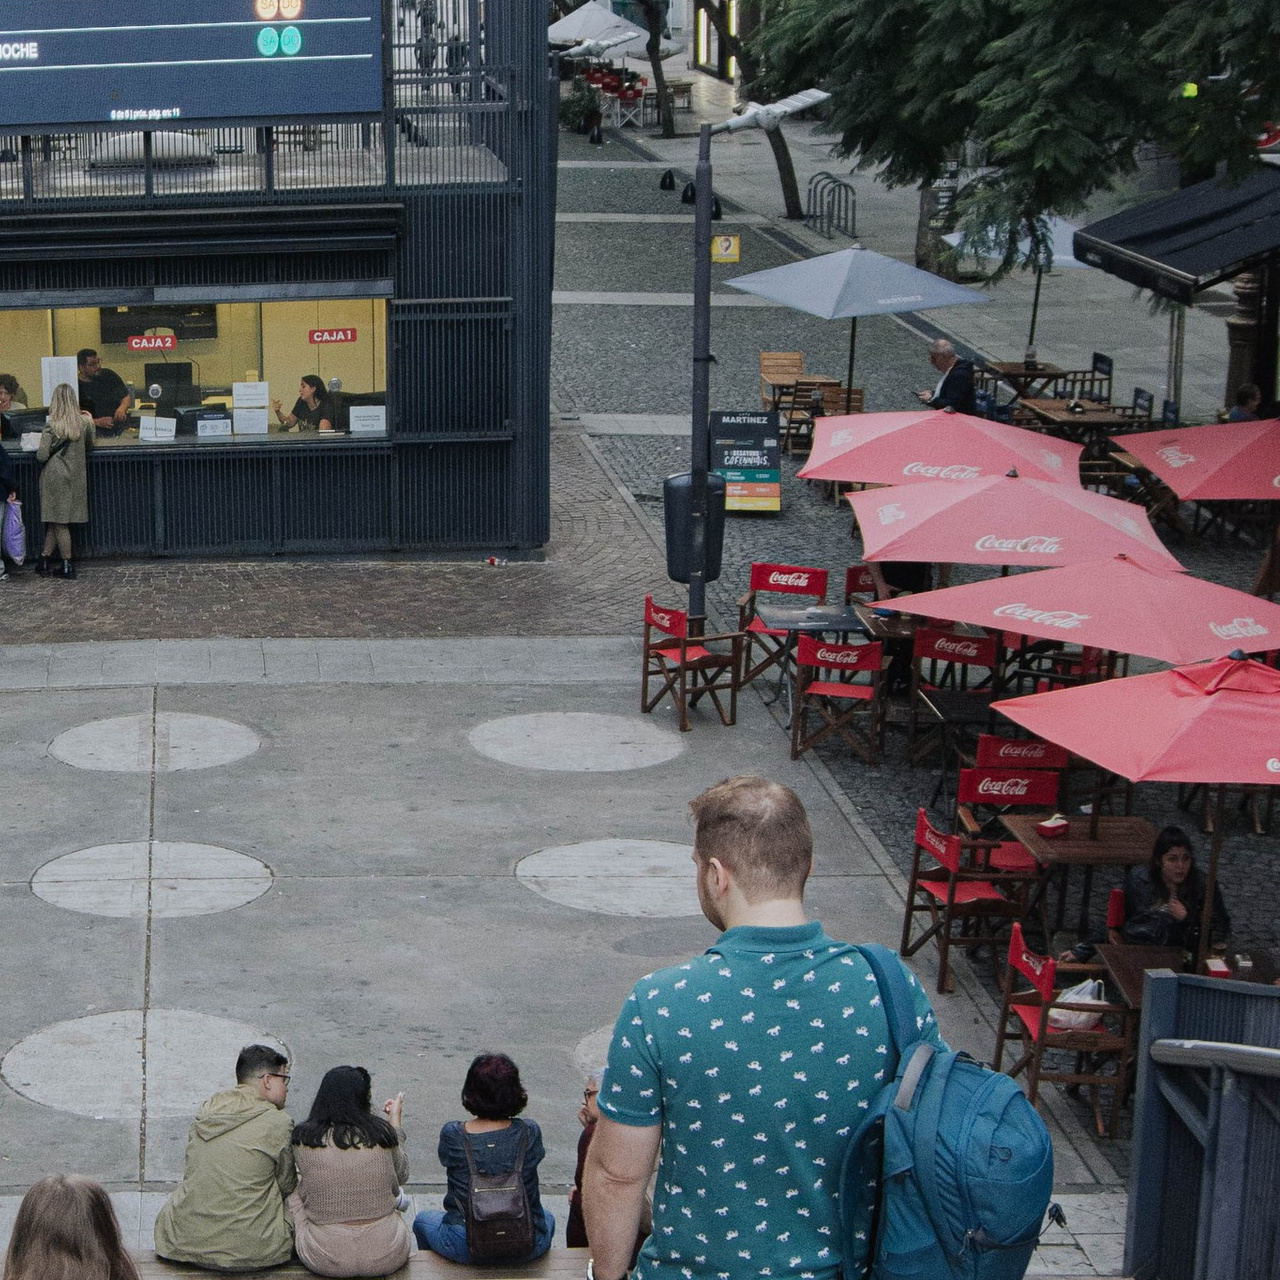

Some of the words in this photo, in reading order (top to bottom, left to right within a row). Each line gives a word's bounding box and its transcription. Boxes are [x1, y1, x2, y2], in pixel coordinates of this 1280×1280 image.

[261, 0, 275, 10] SA
[313, 331, 345, 340] CAJA
[346, 330, 352, 339] 1
[131, 338, 164, 348] CAJA
[165, 337, 172, 346] 2
